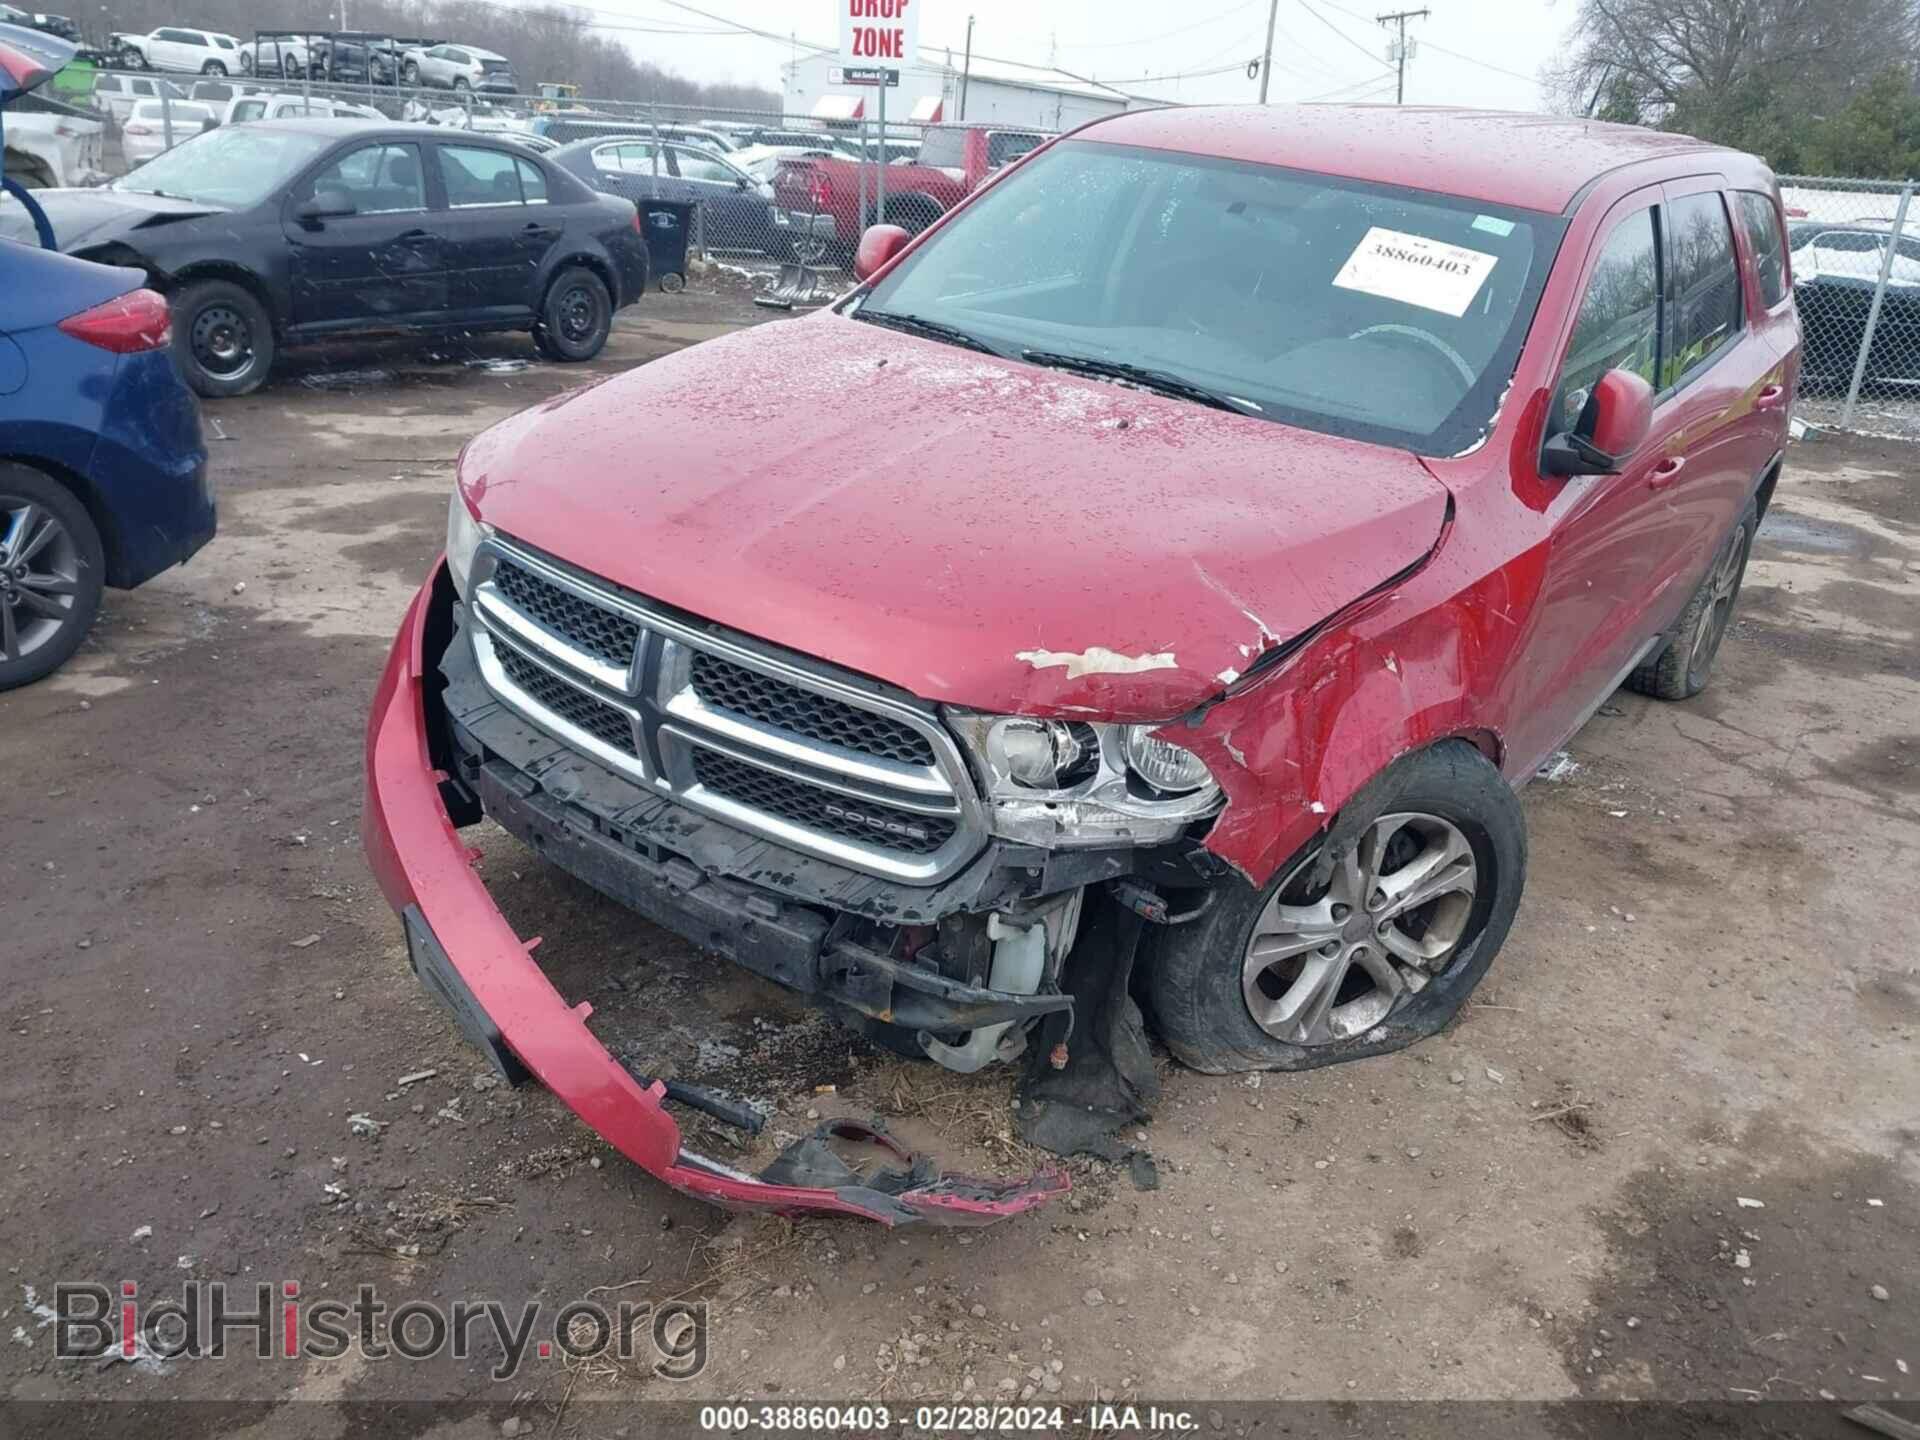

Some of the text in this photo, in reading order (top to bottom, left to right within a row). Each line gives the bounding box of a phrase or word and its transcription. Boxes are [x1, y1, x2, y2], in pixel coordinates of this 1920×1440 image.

[852, 27, 904, 58] ZONE
[1367, 243, 1471, 277] 38860403
[825, 804, 929, 841] DODGE
